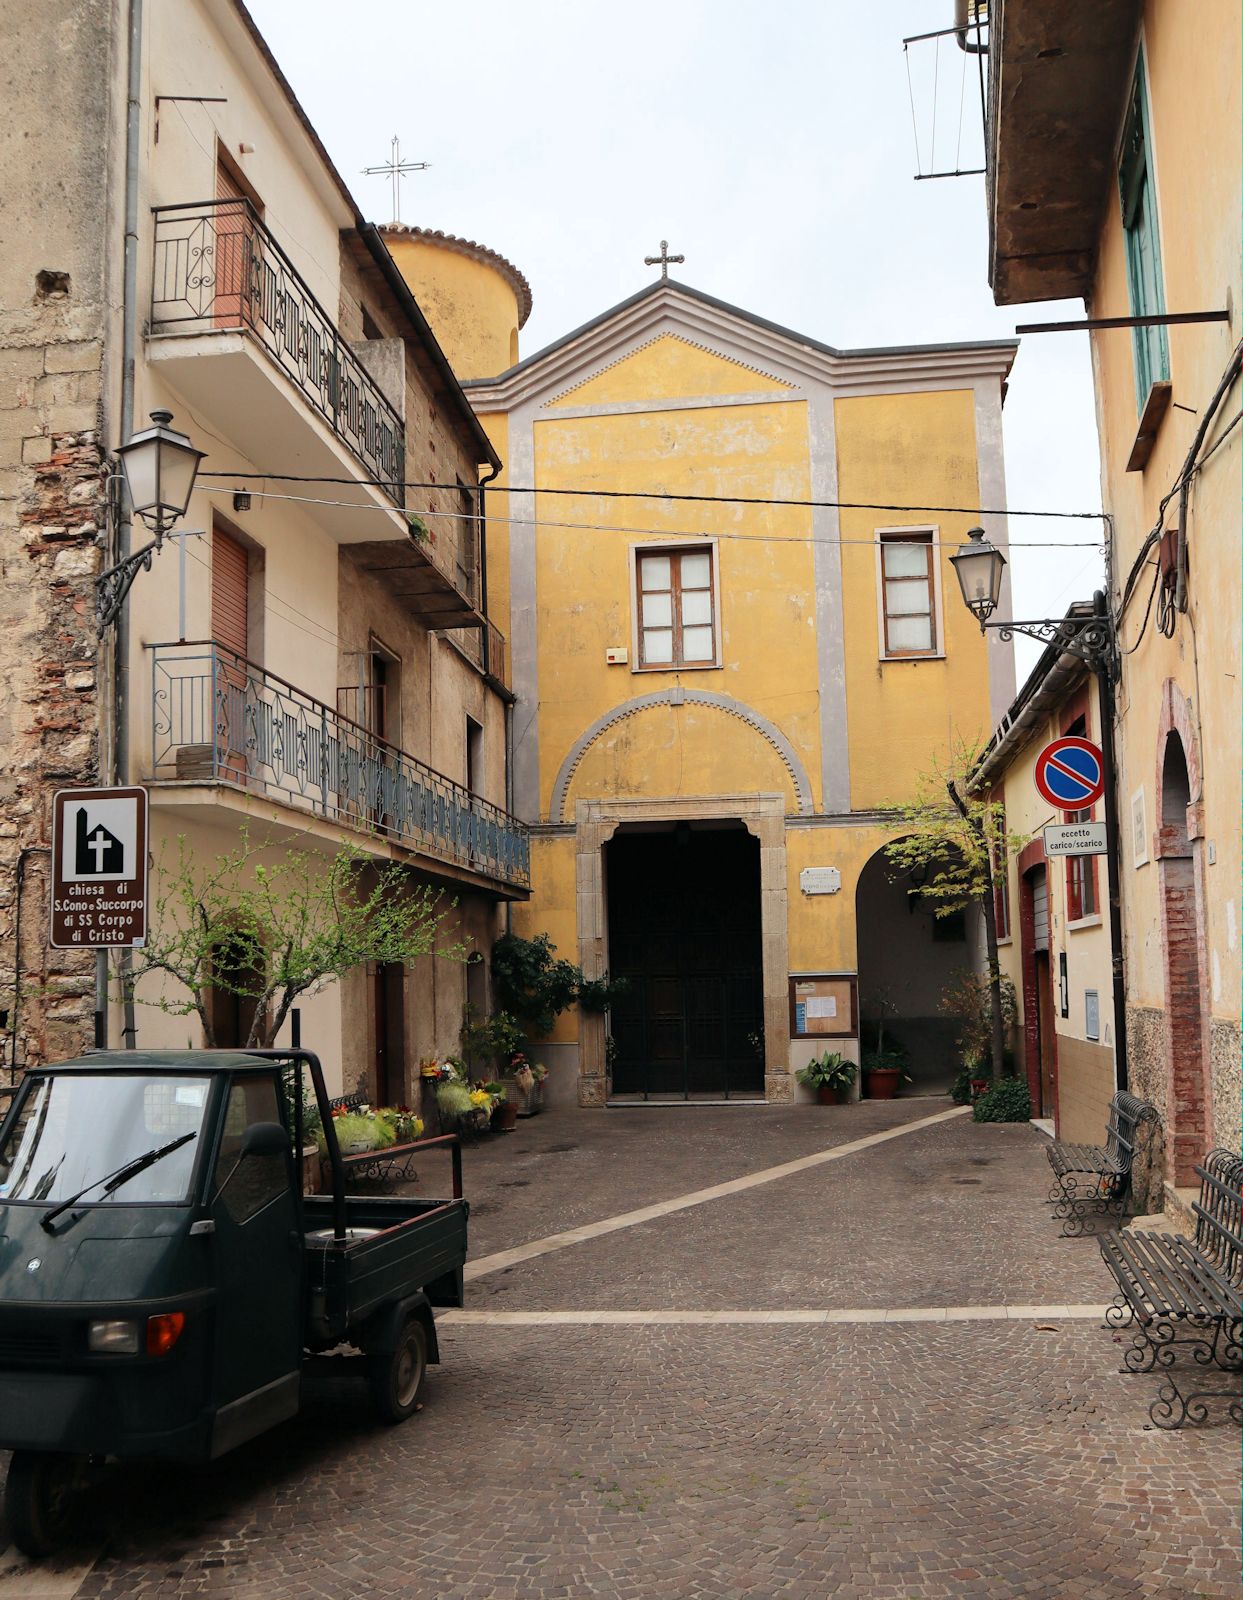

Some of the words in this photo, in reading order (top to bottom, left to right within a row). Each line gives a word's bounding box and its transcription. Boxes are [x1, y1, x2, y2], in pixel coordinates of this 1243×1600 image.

[1061, 829, 1090, 838] eccetto
[1050, 840, 1102, 849] carico/scarico
[69, 884, 105, 895] chiesa
[117, 883, 127, 894] di
[54, 900, 87, 911] S.Cono
[96, 899, 144, 911] Succorpo
[64, 915, 73, 927] di
[79, 915, 92, 926] SS
[98, 914, 133, 927] Corpo
[72, 930, 81, 941] di
[89, 929, 125, 941] Cristo
